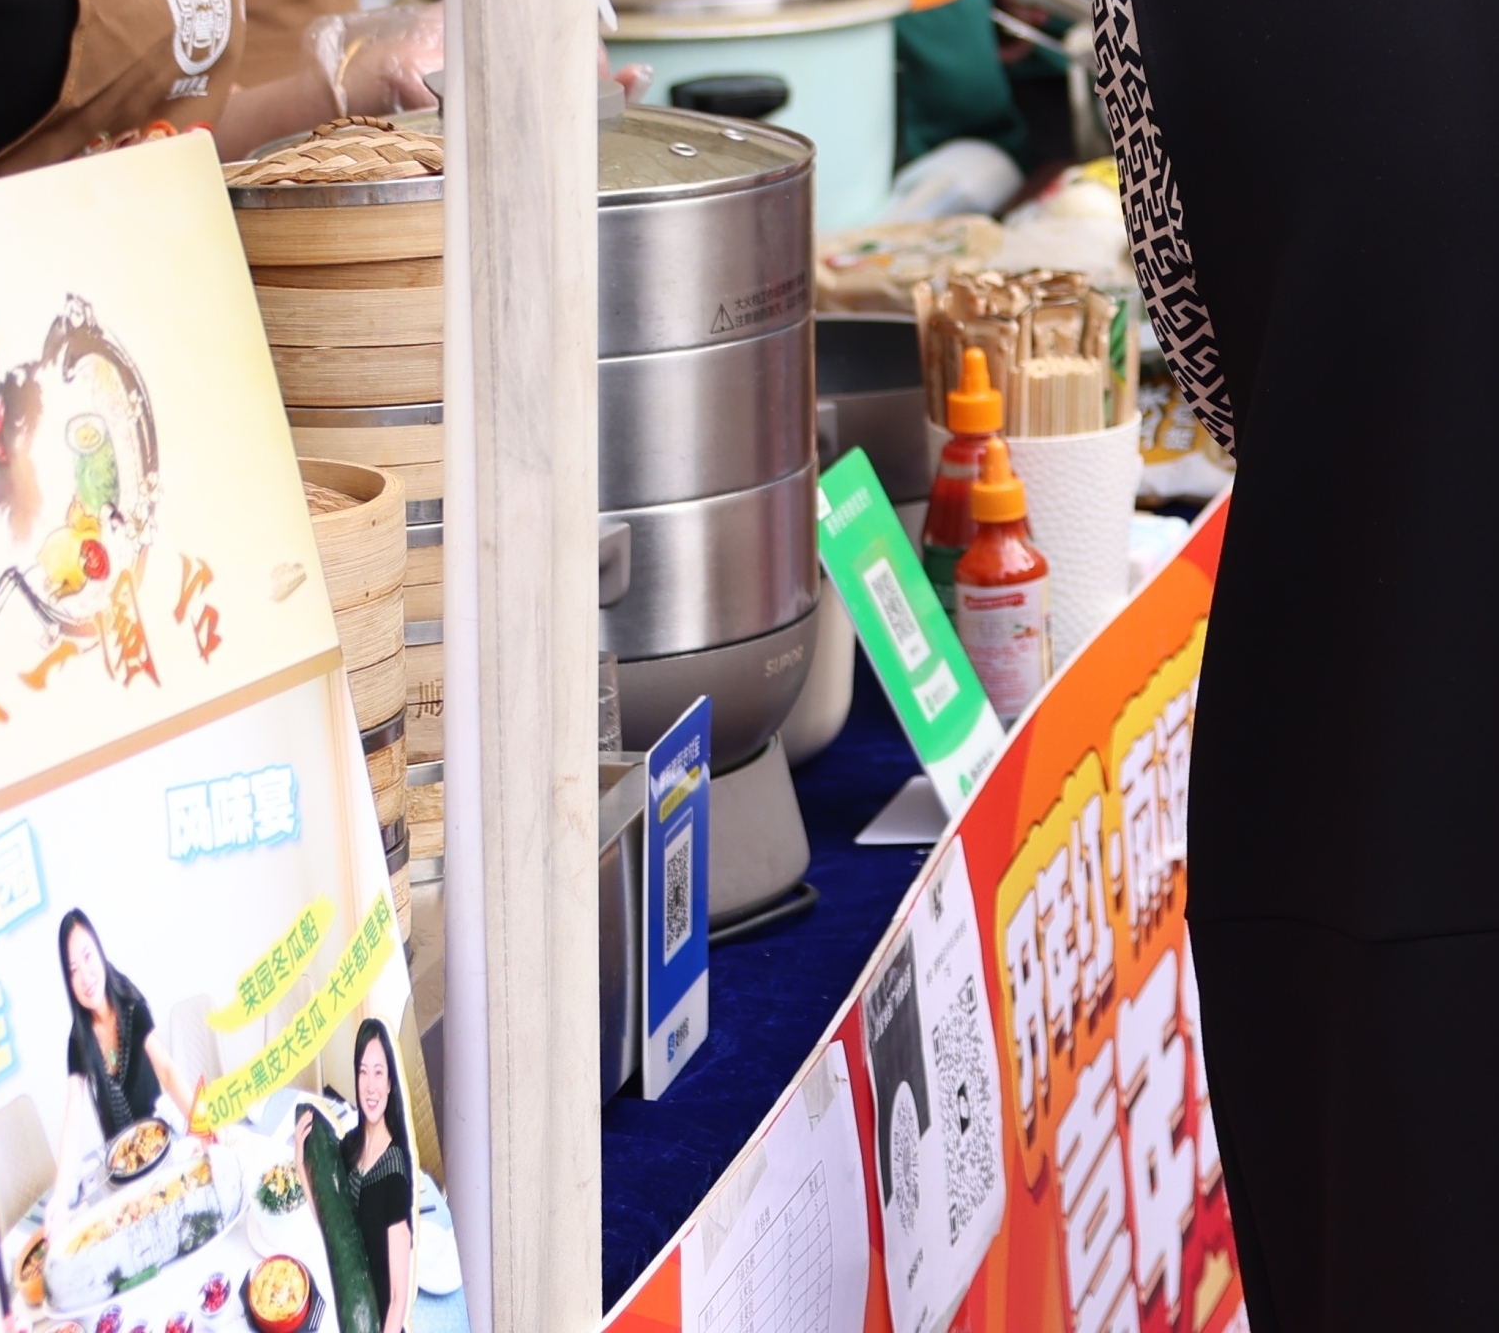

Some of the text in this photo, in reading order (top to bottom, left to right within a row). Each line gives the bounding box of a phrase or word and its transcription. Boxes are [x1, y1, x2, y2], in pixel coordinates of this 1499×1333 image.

[166, 763, 299, 860] 风味宴
[206, 892, 394, 1127] 30斤+黑皮大冬瓜 大半都是料
[237, 910, 321, 1017] 菜园冬瓜船
[1056, 945, 1223, 1333] 嘉年
